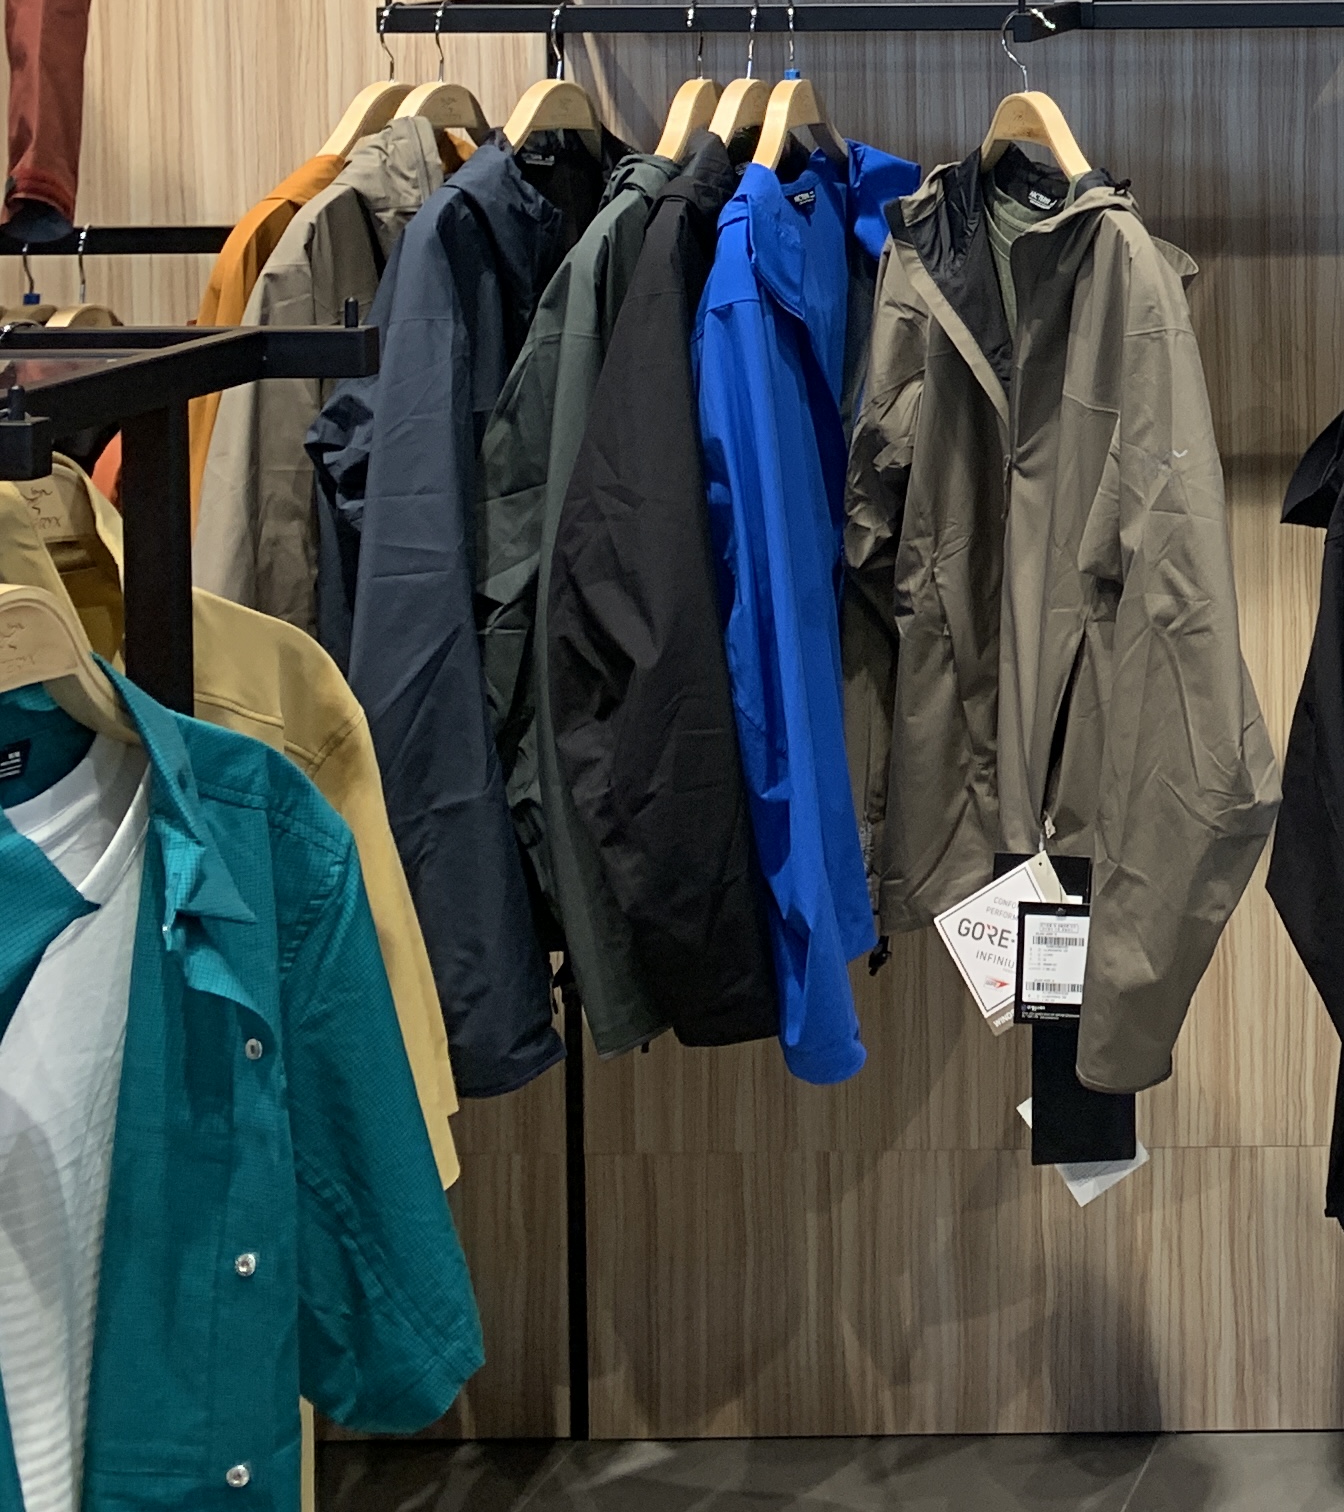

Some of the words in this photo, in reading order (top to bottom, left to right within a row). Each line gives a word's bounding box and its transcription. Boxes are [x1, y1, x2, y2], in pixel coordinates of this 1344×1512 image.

[993, 896, 1018, 909] CONFO
[957, 917, 1018, 949] GORE-
[976, 949, 1015, 969] INFINIU
